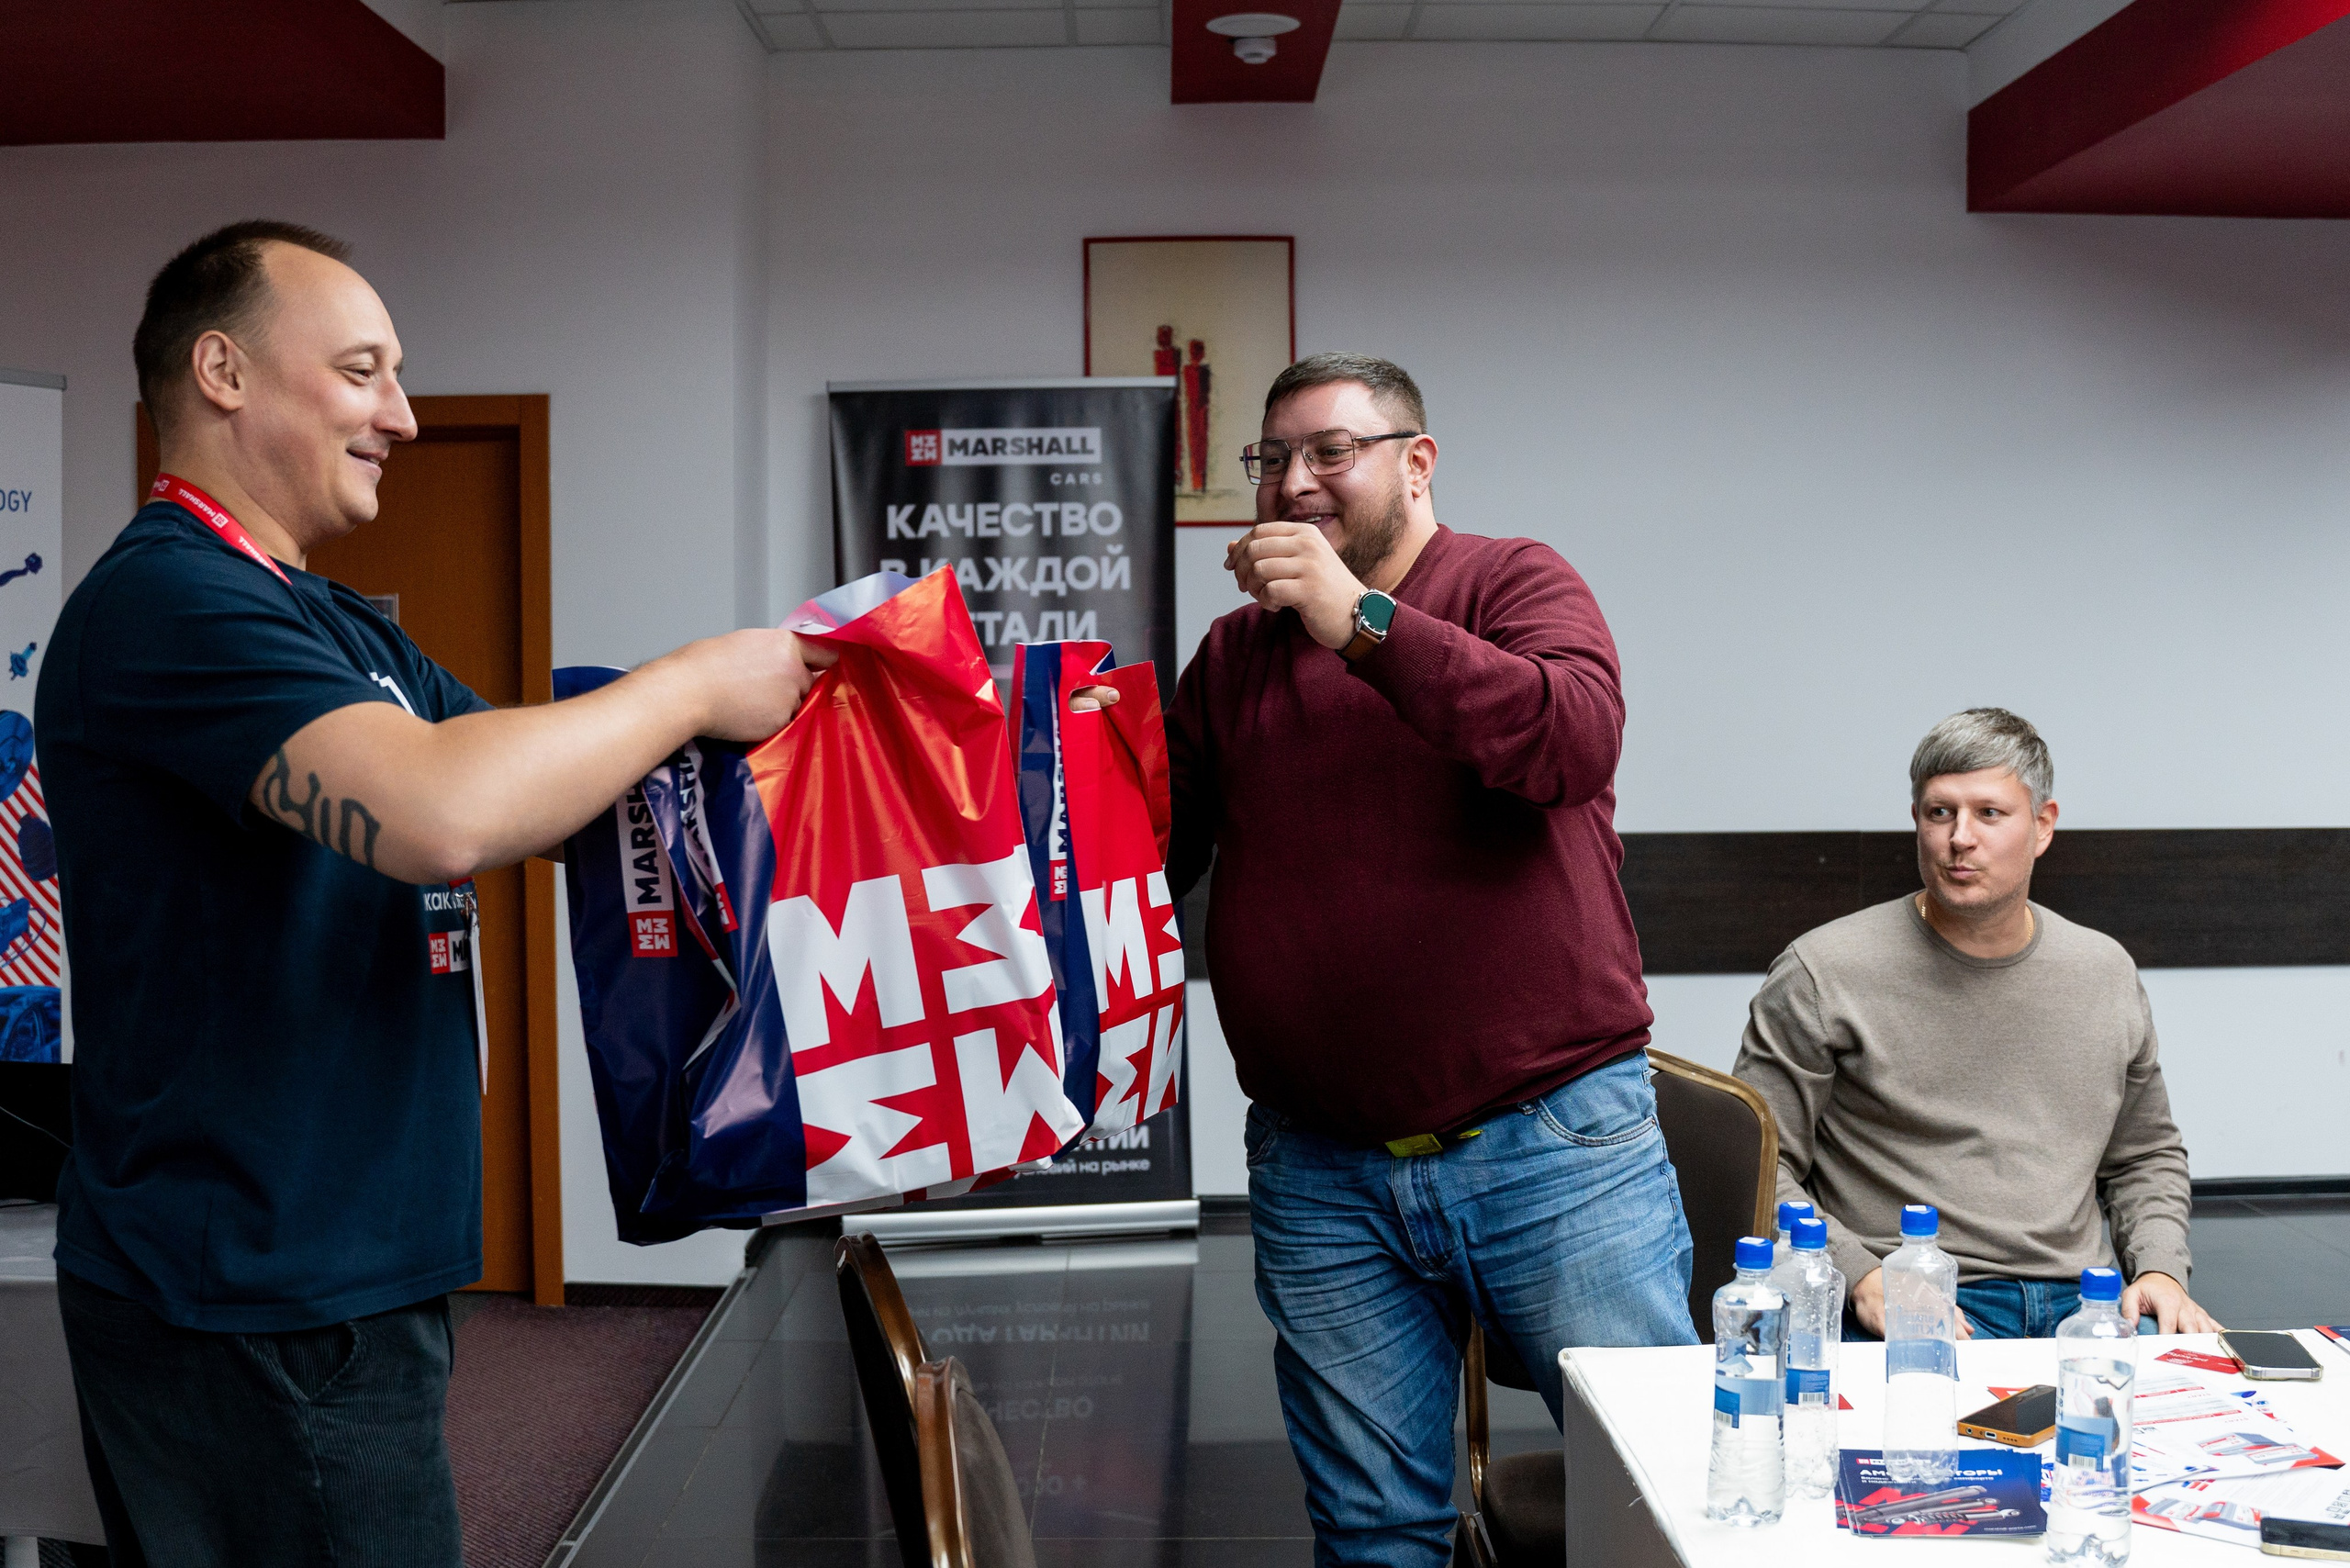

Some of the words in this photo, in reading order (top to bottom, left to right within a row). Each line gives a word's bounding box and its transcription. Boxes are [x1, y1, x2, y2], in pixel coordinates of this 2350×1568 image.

[947, 436, 1095, 456] MARSHALL
[1050, 472, 1102, 485] CARS
[178, 487, 217, 518] MARSHALL
[886, 502, 1125, 540] КАЧЕСТВО
[238, 535, 273, 569] ARSHALL
[967, 610, 1097, 646] ТАЛИ
[423, 891, 453, 912] как
[1079, 1160, 1101, 1174] на
[1102, 1159, 1150, 1176] рынке
